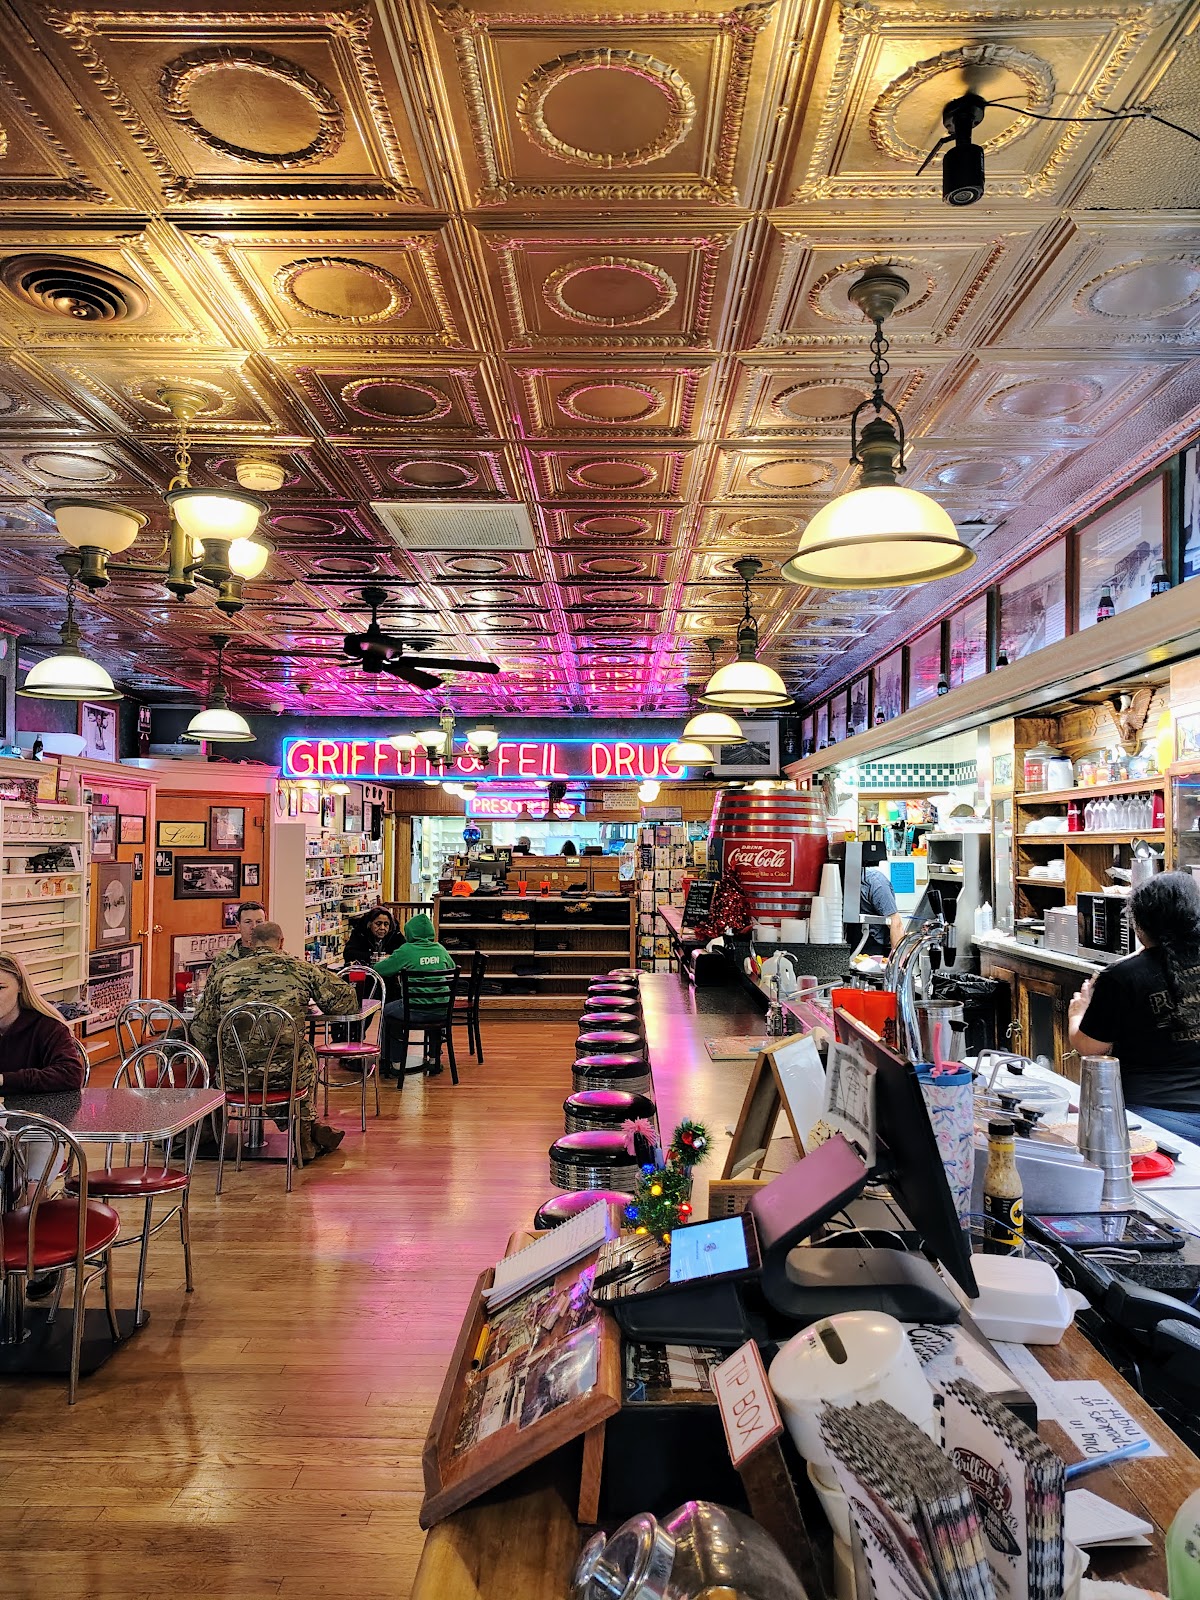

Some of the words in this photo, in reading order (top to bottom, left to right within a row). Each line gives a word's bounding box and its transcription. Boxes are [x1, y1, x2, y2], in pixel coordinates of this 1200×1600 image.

[498, 742, 569, 779] FEIL
[162, 825, 201, 843] Ladies
[728, 848, 788, 868] Coca-Cola
[419, 956, 440, 966] EDEN
[725, 1354, 750, 1388] TIP
[1073, 1396, 1094, 1407] at
[732, 1389, 764, 1446] BOX
[1069, 1420, 1085, 1430] in
[949, 1450, 996, 1489] Griffith
